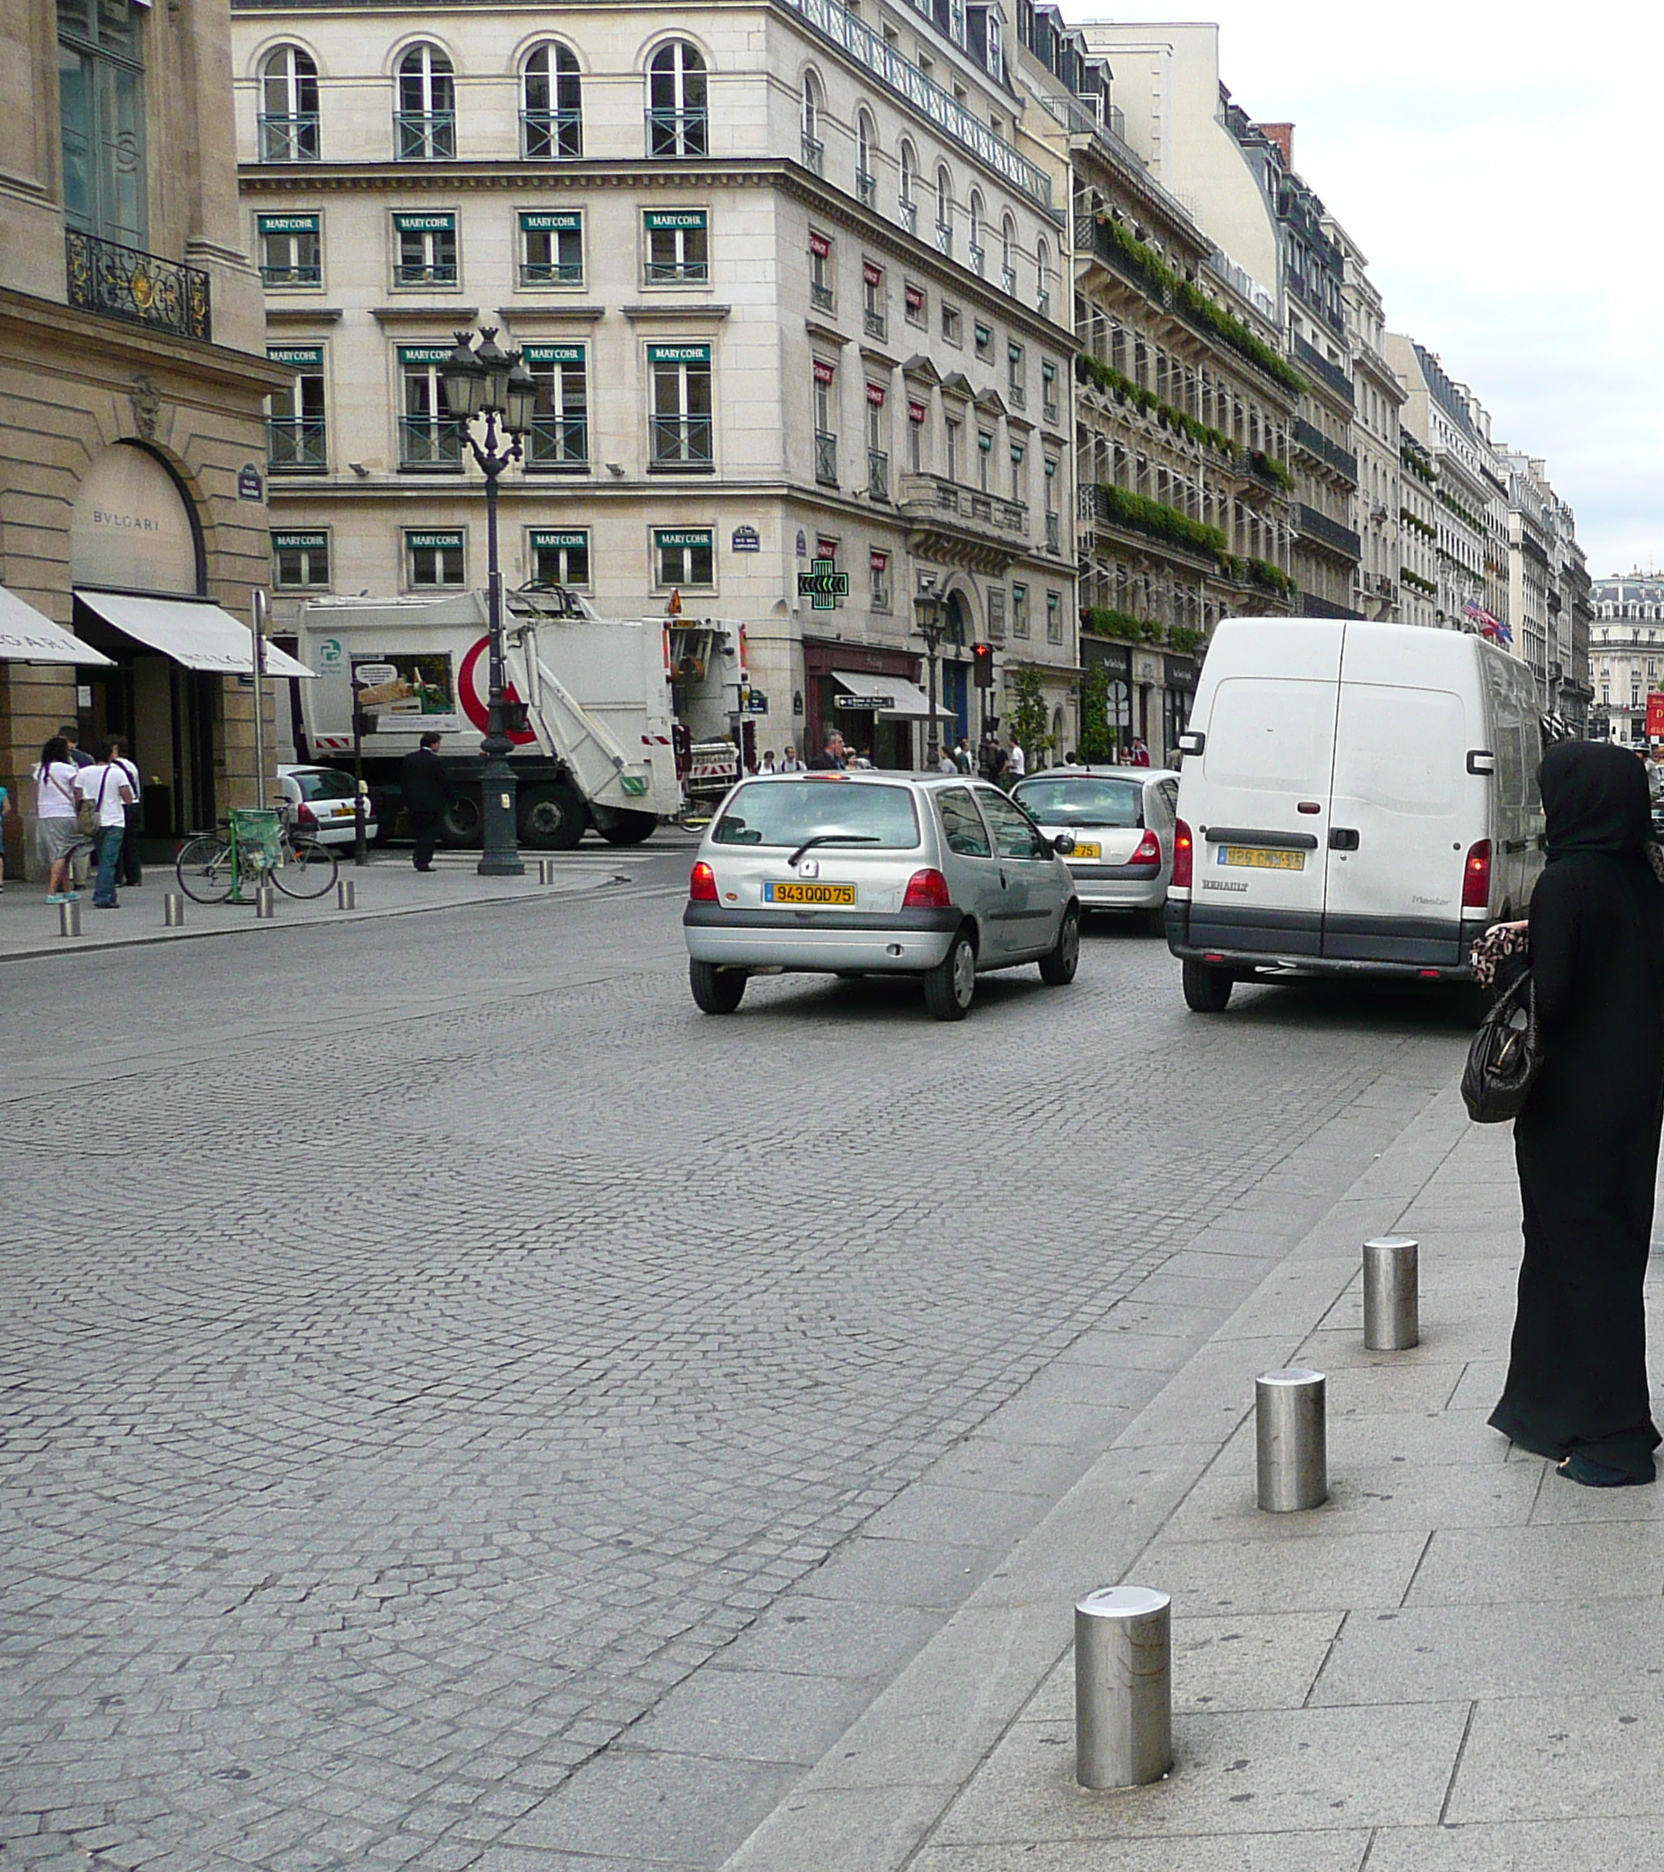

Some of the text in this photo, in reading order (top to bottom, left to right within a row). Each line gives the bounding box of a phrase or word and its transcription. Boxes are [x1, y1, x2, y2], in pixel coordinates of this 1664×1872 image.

[266, 219, 312, 228] MARY COHR
[401, 218, 448, 227] MARY COHR
[528, 217, 575, 226] MARY COHR
[653, 216, 701, 225] MARY COHR
[270, 351, 316, 360] MARY COHR
[406, 350, 429, 359] MARY
[530, 349, 577, 359] MARY COHR
[656, 349, 703, 358] MARY COHR
[93, 510, 159, 531] BVLGARI
[278, 536, 323, 544] MARY COHR
[413, 535, 458, 544] MARY COHR
[537, 535, 584, 544] MARY COHR
[662, 534, 708, 542] MARY COHR
[1202, 880, 1249, 893] RENAULT
[1412, 895, 1452, 906] Master
